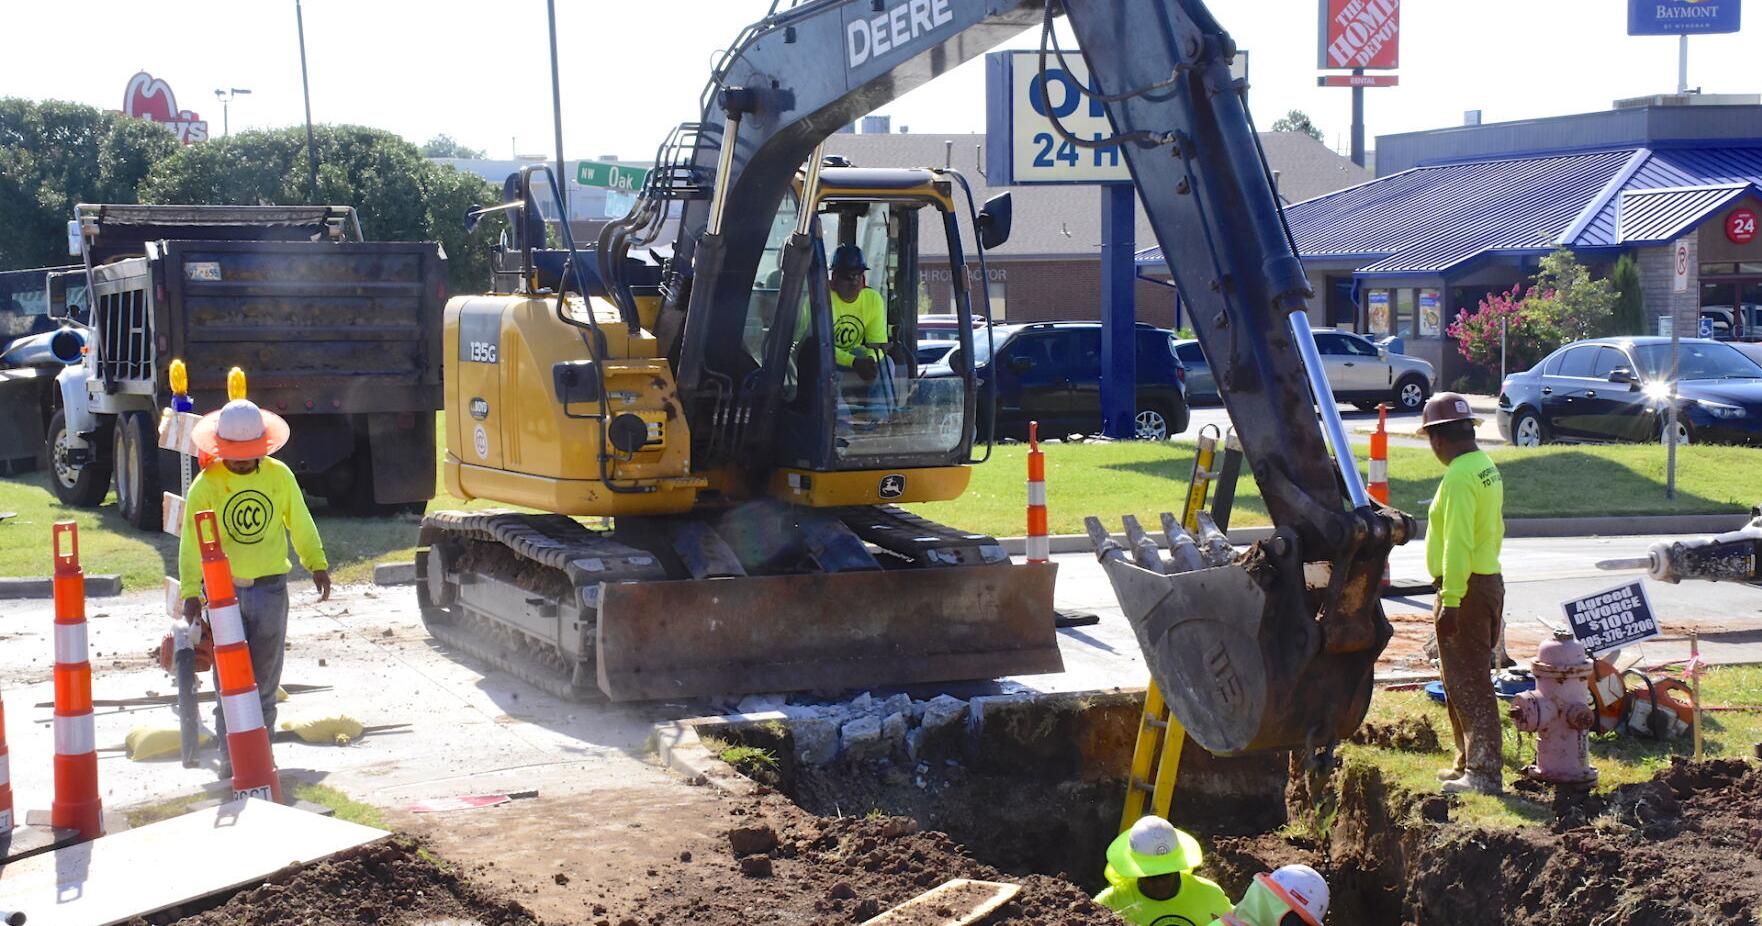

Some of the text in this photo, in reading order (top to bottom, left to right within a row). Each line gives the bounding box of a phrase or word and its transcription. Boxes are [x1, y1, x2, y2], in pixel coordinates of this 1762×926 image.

[1335, 0, 1365, 27] THE
[1656, 5, 1719, 19] BAYMONT
[847, 0, 953, 68] DEERE
[1355, 16, 1398, 67] DEPOT
[1033, 132, 1079, 167] 24
[581, 166, 634, 189] NW Oak
[1734, 218, 1755, 233] 24
[470, 341, 496, 363] 135G
[1573, 596, 1642, 625] DIVORCE
[1575, 586, 1633, 612] Agreed
[1588, 610, 1634, 631] $100
